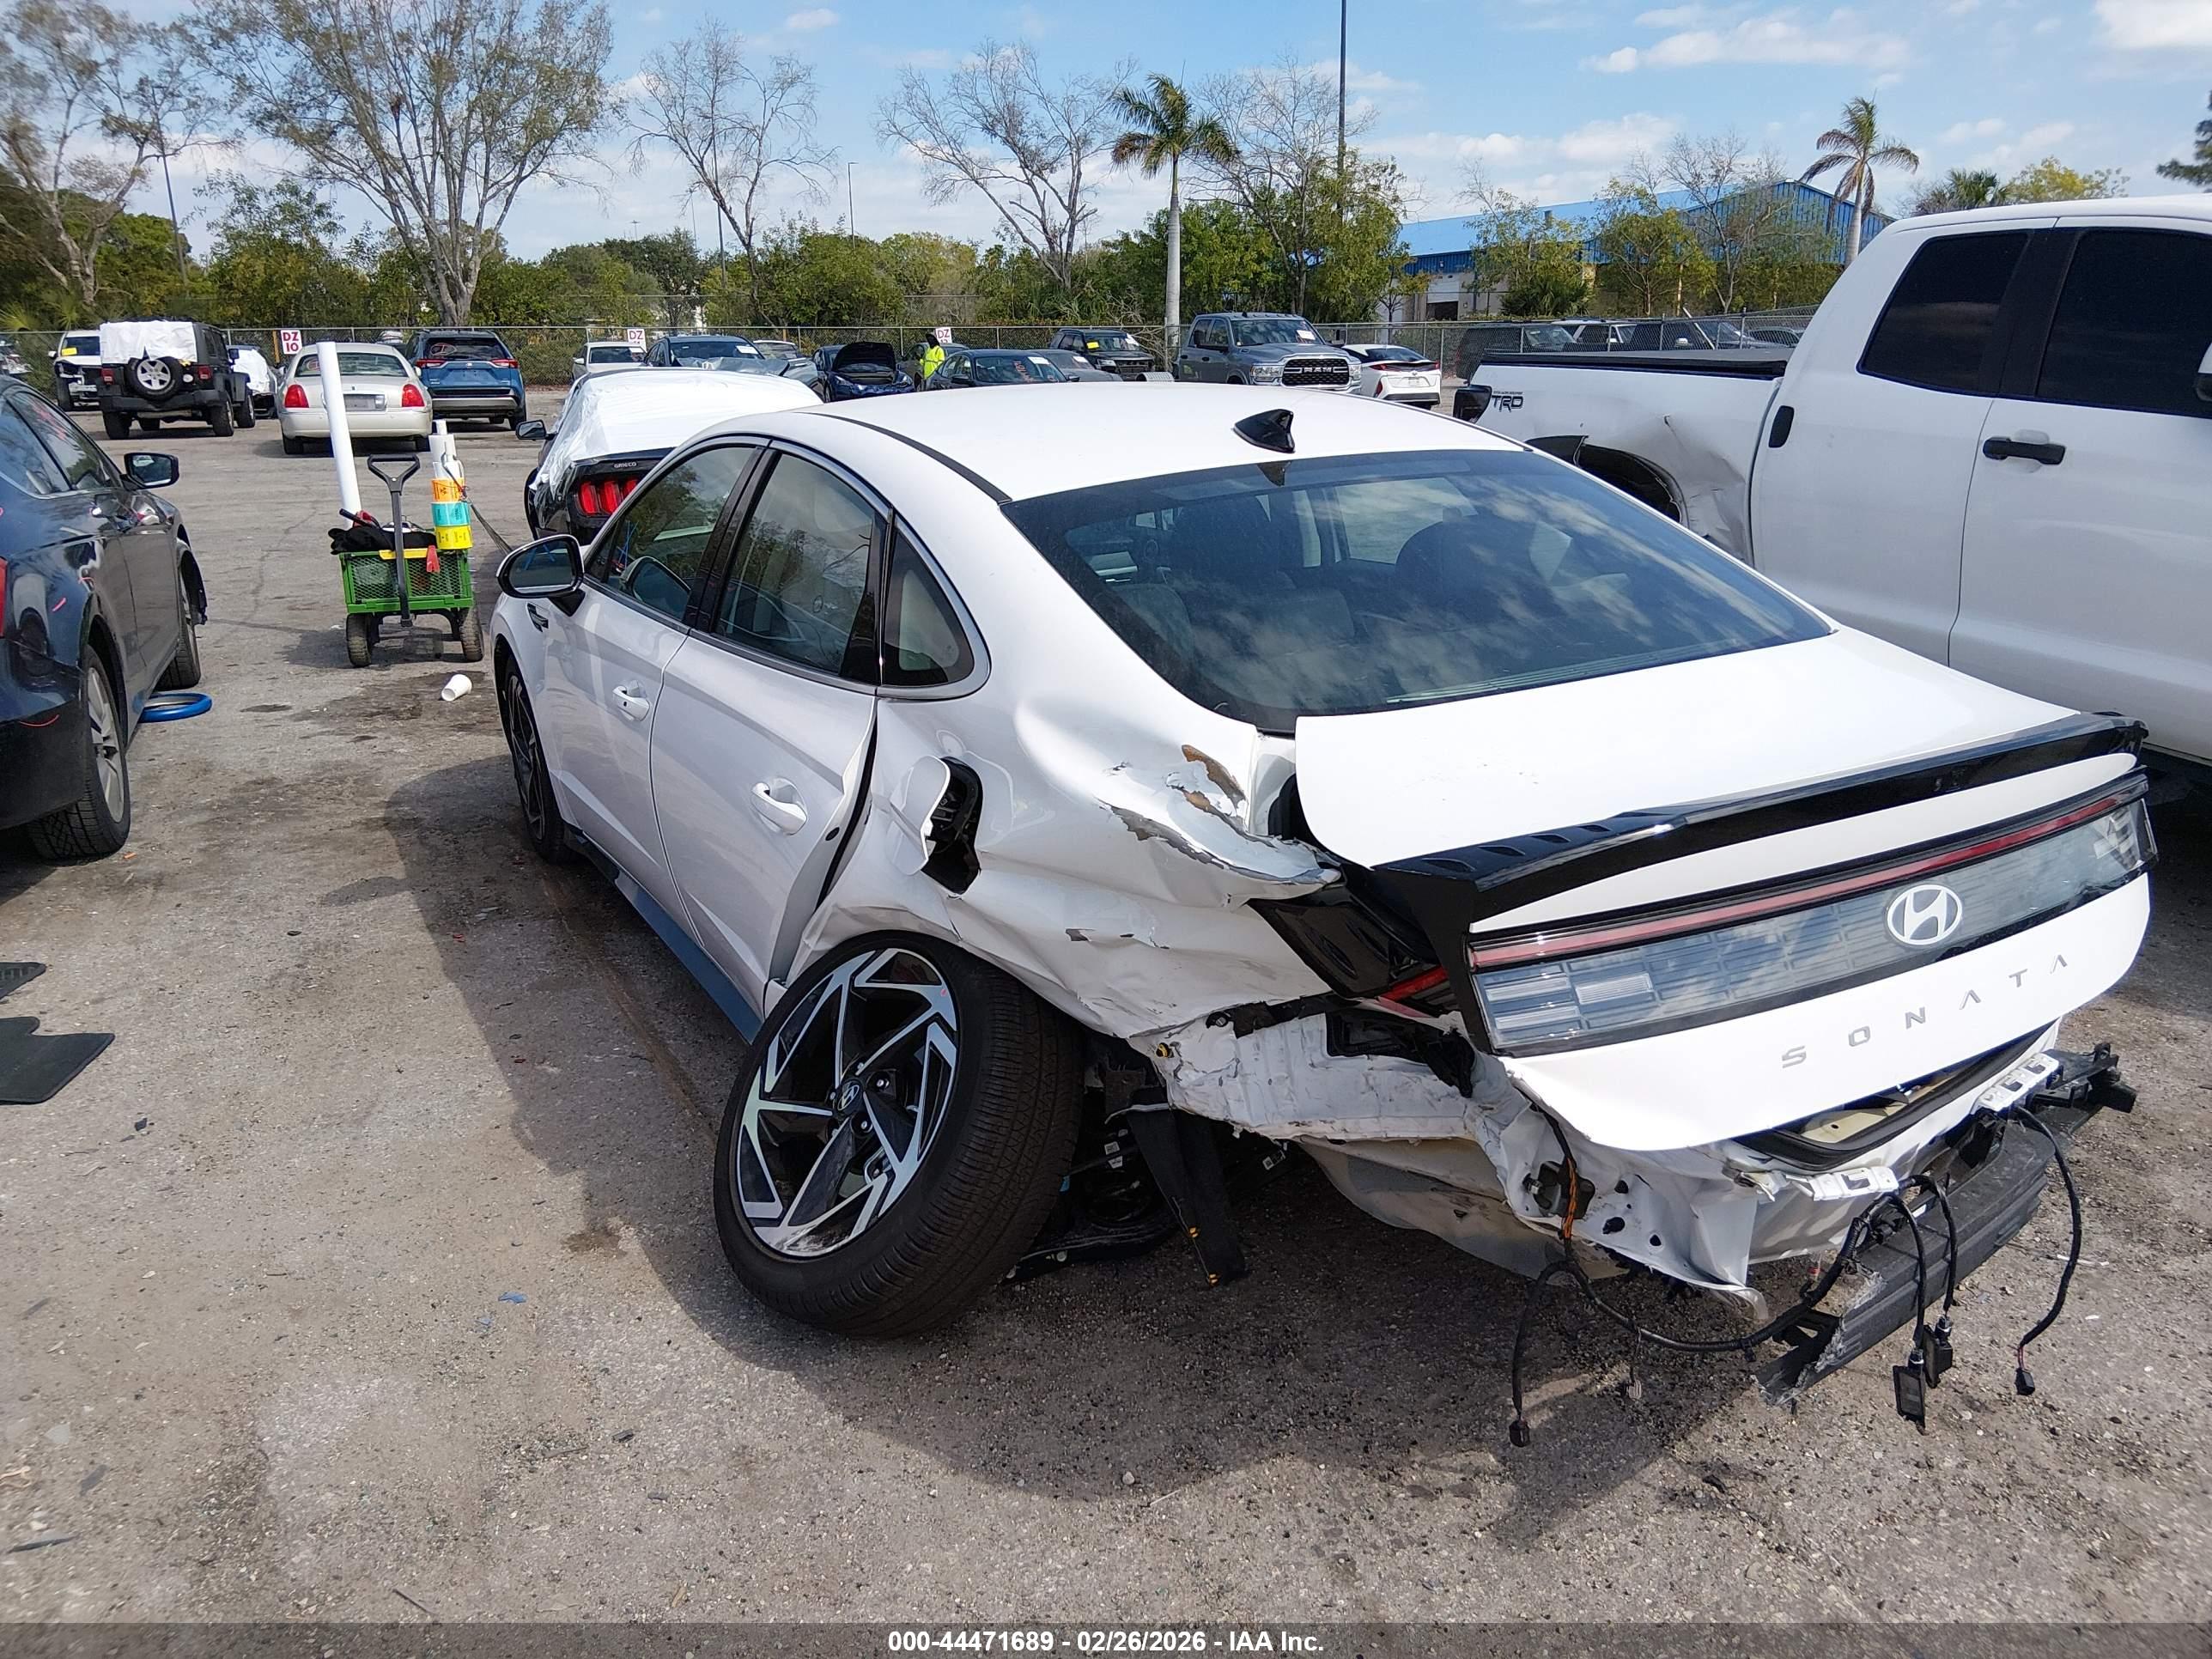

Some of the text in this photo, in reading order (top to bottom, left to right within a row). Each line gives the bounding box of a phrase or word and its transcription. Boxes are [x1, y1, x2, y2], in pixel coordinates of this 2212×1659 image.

[283, 331, 299, 342] DZ
[629, 331, 643, 339] DZ
[938, 329, 950, 338] DZ
[286, 343, 299, 352] 10
[1492, 395, 1523, 412] TRD
[1782, 954, 2068, 1068] SONATA
